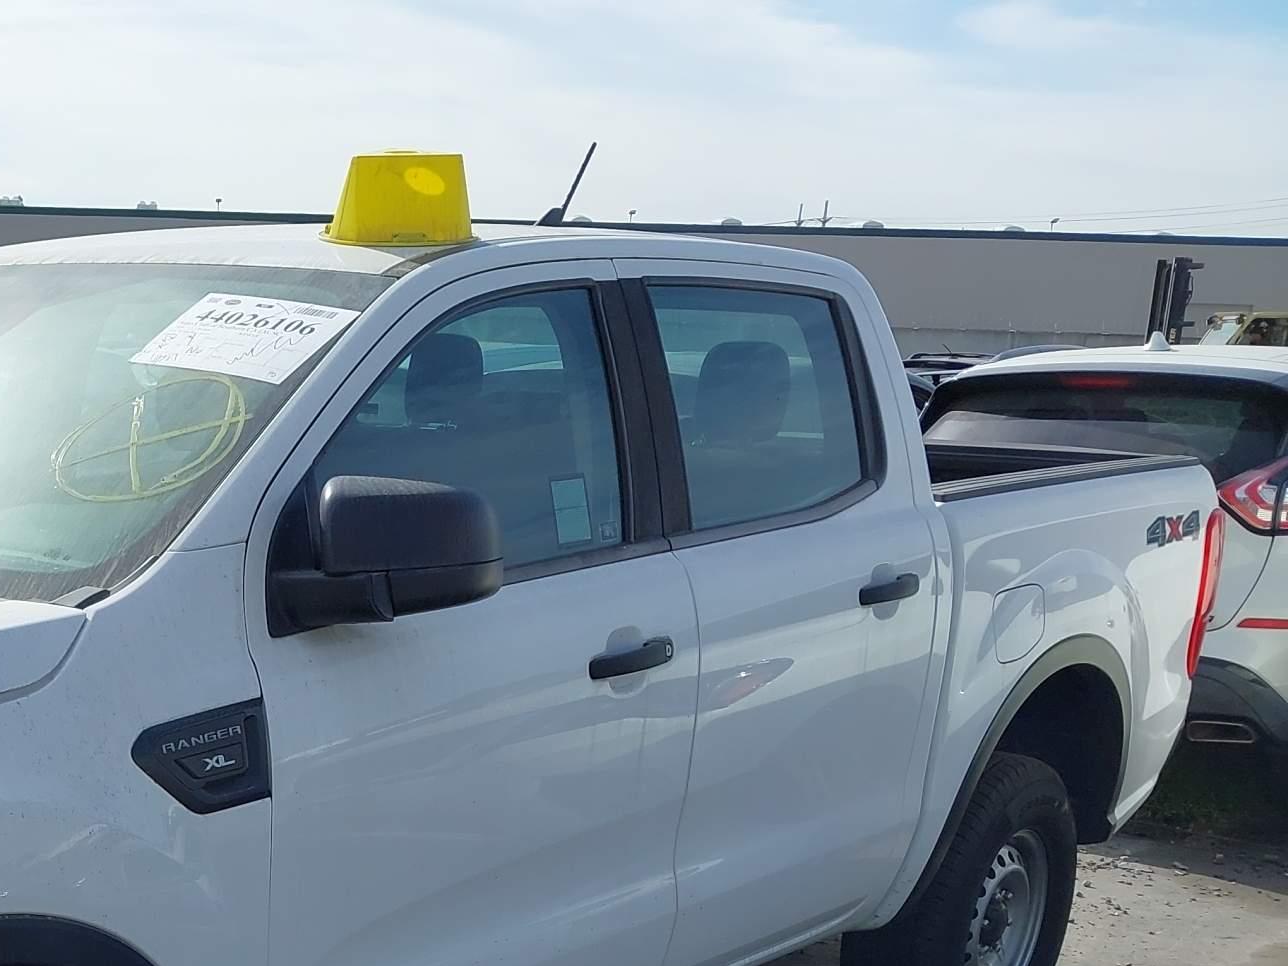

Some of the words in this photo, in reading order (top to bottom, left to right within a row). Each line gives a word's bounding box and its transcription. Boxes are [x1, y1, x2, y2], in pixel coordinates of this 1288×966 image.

[197, 309, 321, 336] 44026106
[162, 725, 242, 754] RANGER
[202, 754, 236, 772] XL
